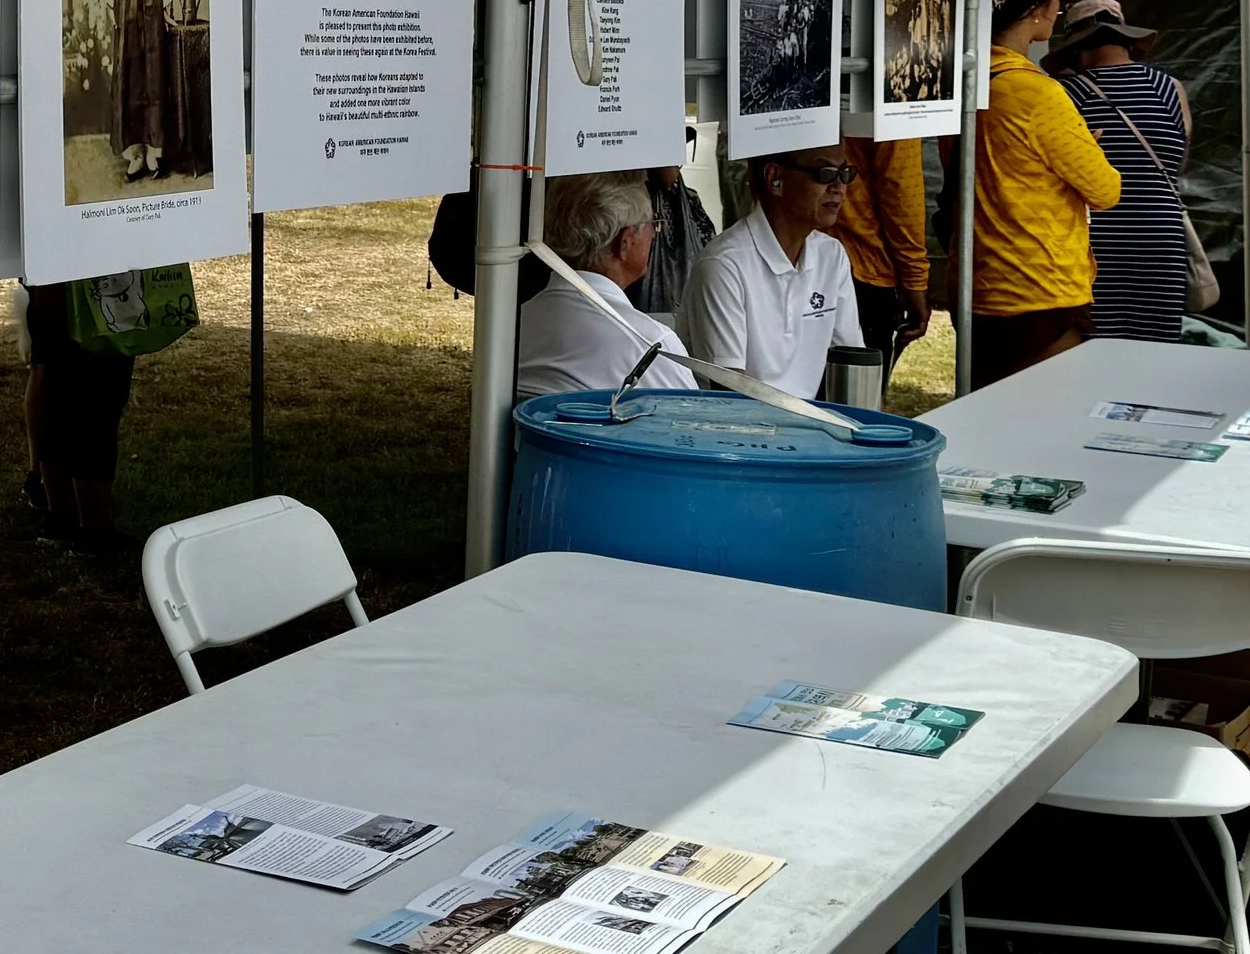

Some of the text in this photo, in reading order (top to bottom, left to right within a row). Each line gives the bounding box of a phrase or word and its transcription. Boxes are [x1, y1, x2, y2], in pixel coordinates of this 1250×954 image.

[81, 209, 105, 219] Halmoni
[105, 207, 116, 216] Lim
[117, 205, 125, 215] Ok
[141, 202, 160, 211] Picture
[176, 198, 188, 207] circa
